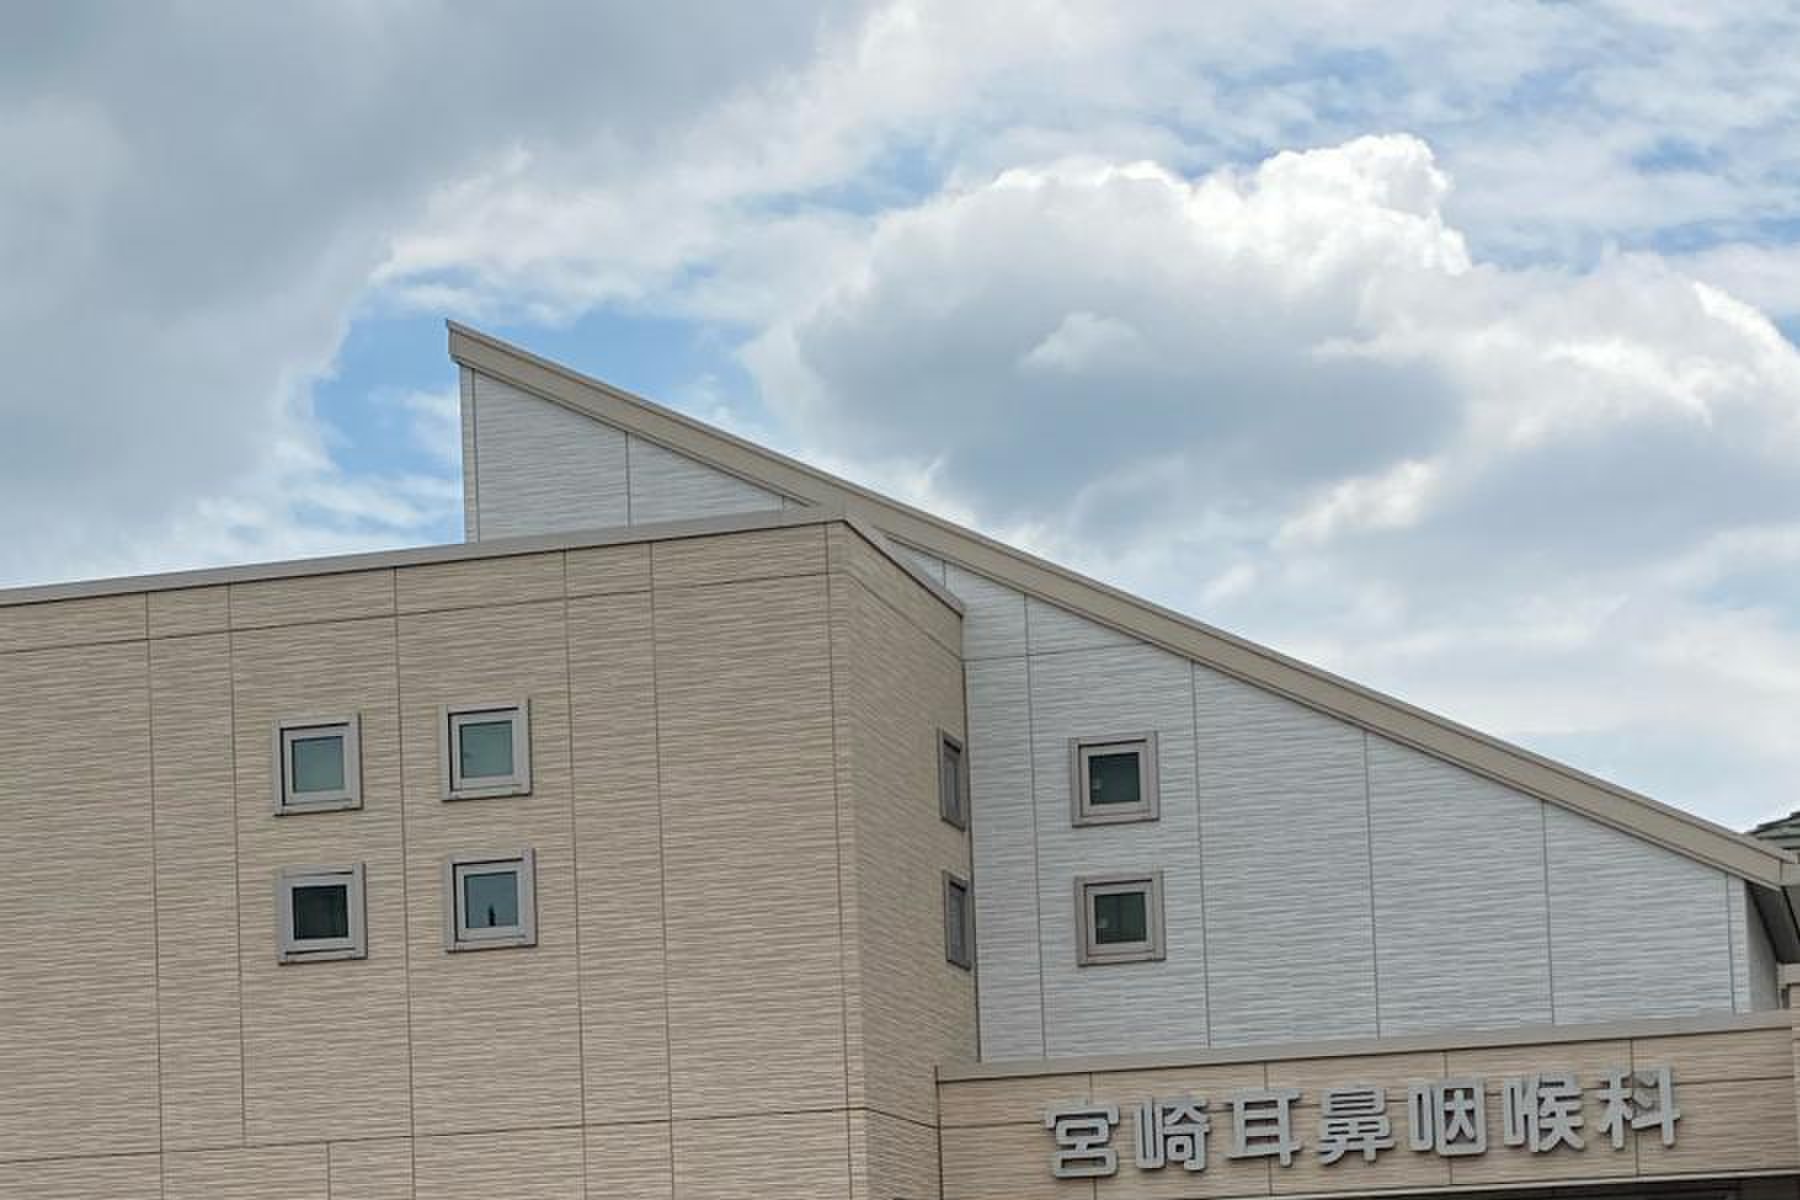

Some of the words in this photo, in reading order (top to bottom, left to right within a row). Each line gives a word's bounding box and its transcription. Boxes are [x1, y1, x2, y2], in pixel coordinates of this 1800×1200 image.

[1045, 1065, 1681, 1178] 宮崎耳鼻咽喉科
